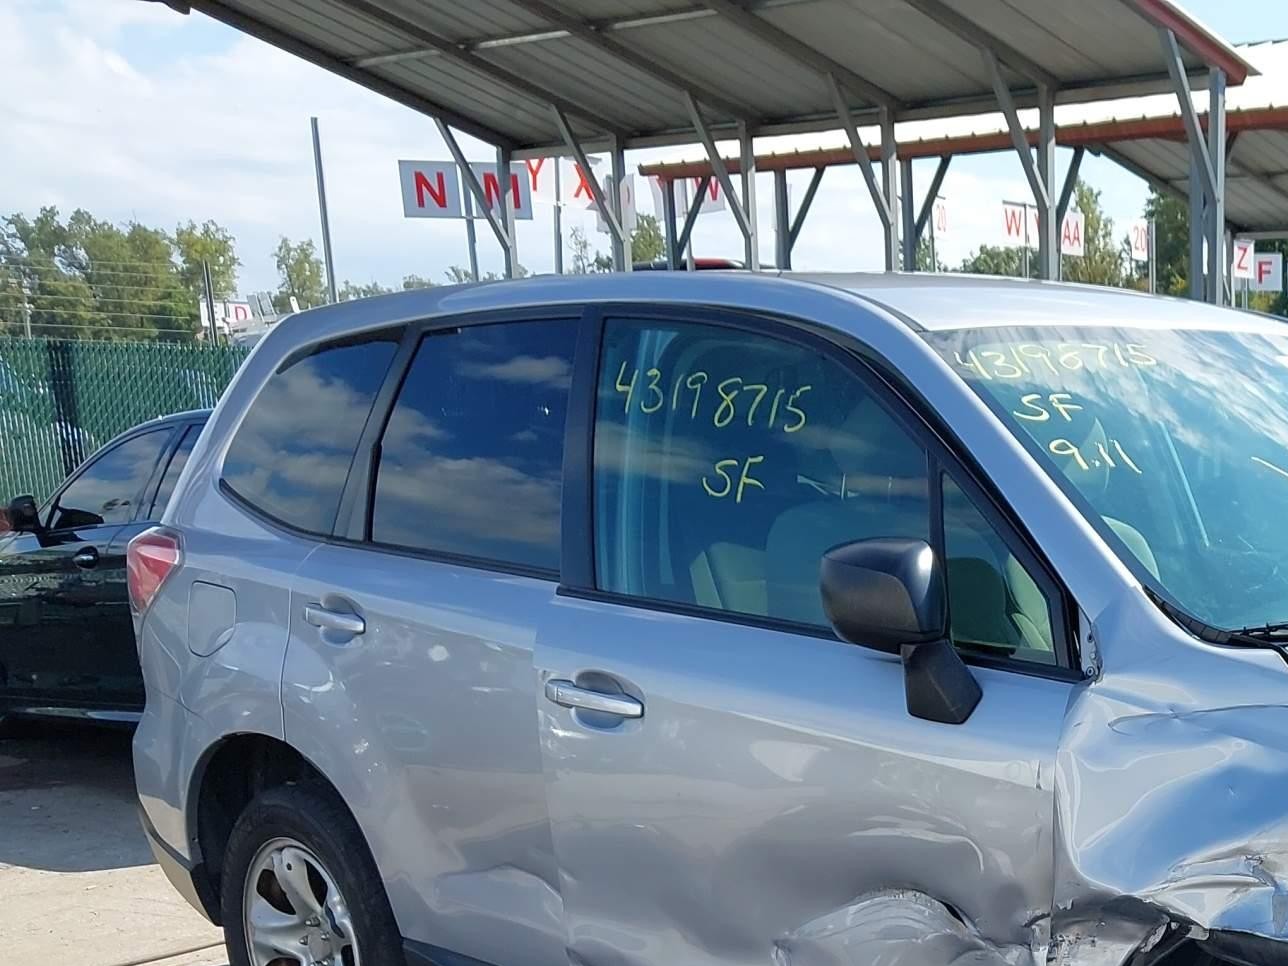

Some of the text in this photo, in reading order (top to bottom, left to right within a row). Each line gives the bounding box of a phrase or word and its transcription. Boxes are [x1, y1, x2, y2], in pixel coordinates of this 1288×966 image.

[413, 170, 448, 208] N
[482, 172, 521, 209] M
[525, 156, 545, 192] Y
[573, 162, 596, 201] X
[1004, 208, 1022, 237] W
[1062, 218, 1082, 247] AA
[1237, 246, 1249, 271] Z
[1257, 261, 1273, 284] F
[953, 341, 1157, 380] 43198715
[615, 360, 812, 433] 43198715
[1013, 393, 1083, 422] SF
[1049, 437, 1142, 475] 9.11
[702, 455, 765, 503] SF
